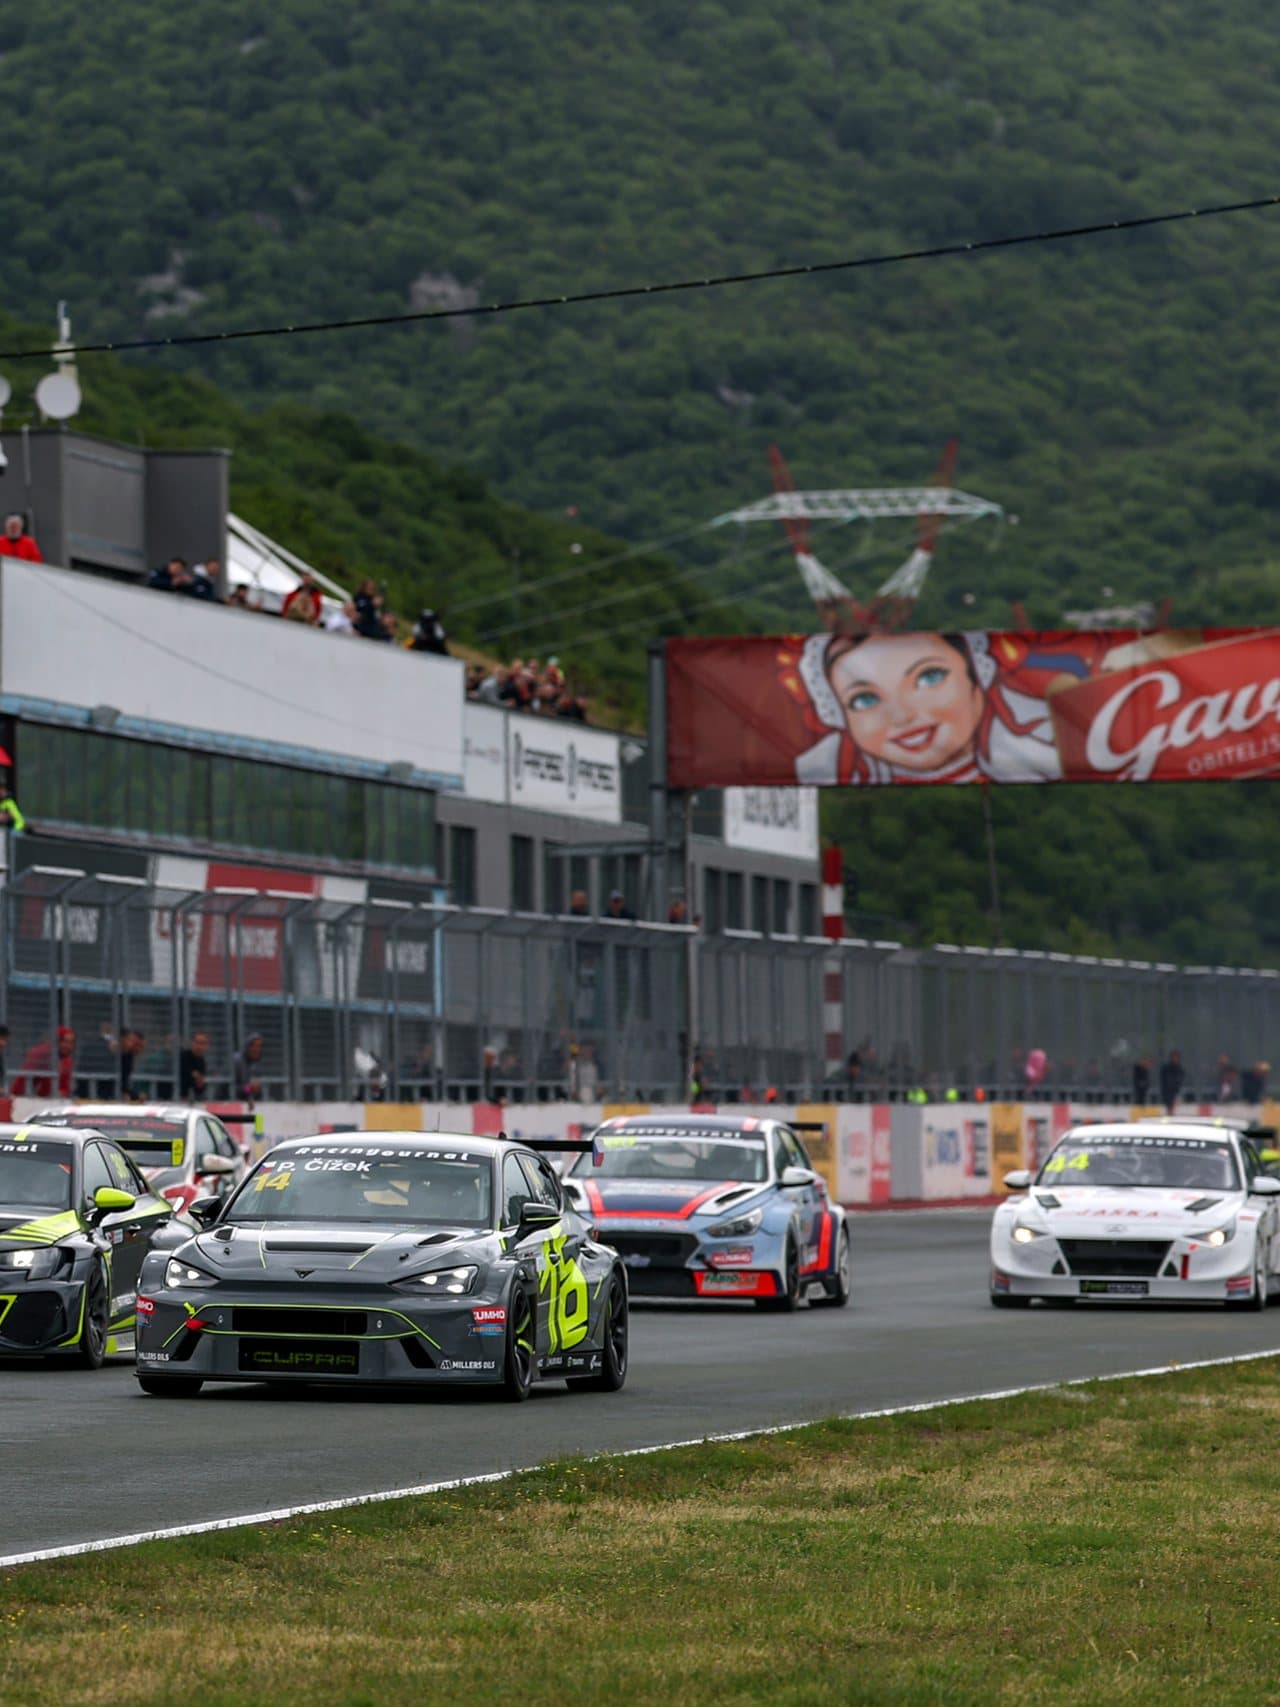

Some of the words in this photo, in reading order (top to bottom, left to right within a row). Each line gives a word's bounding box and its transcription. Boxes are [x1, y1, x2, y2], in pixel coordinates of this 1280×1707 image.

[1086, 670, 1280, 782] Gav
[277, 1161, 296, 1172] P.
[1045, 1152, 1090, 1173] 44
[253, 1172, 292, 1192] 14
[254, 1351, 357, 1366] CUPRA
[452, 1360, 482, 1370] MILLERS
